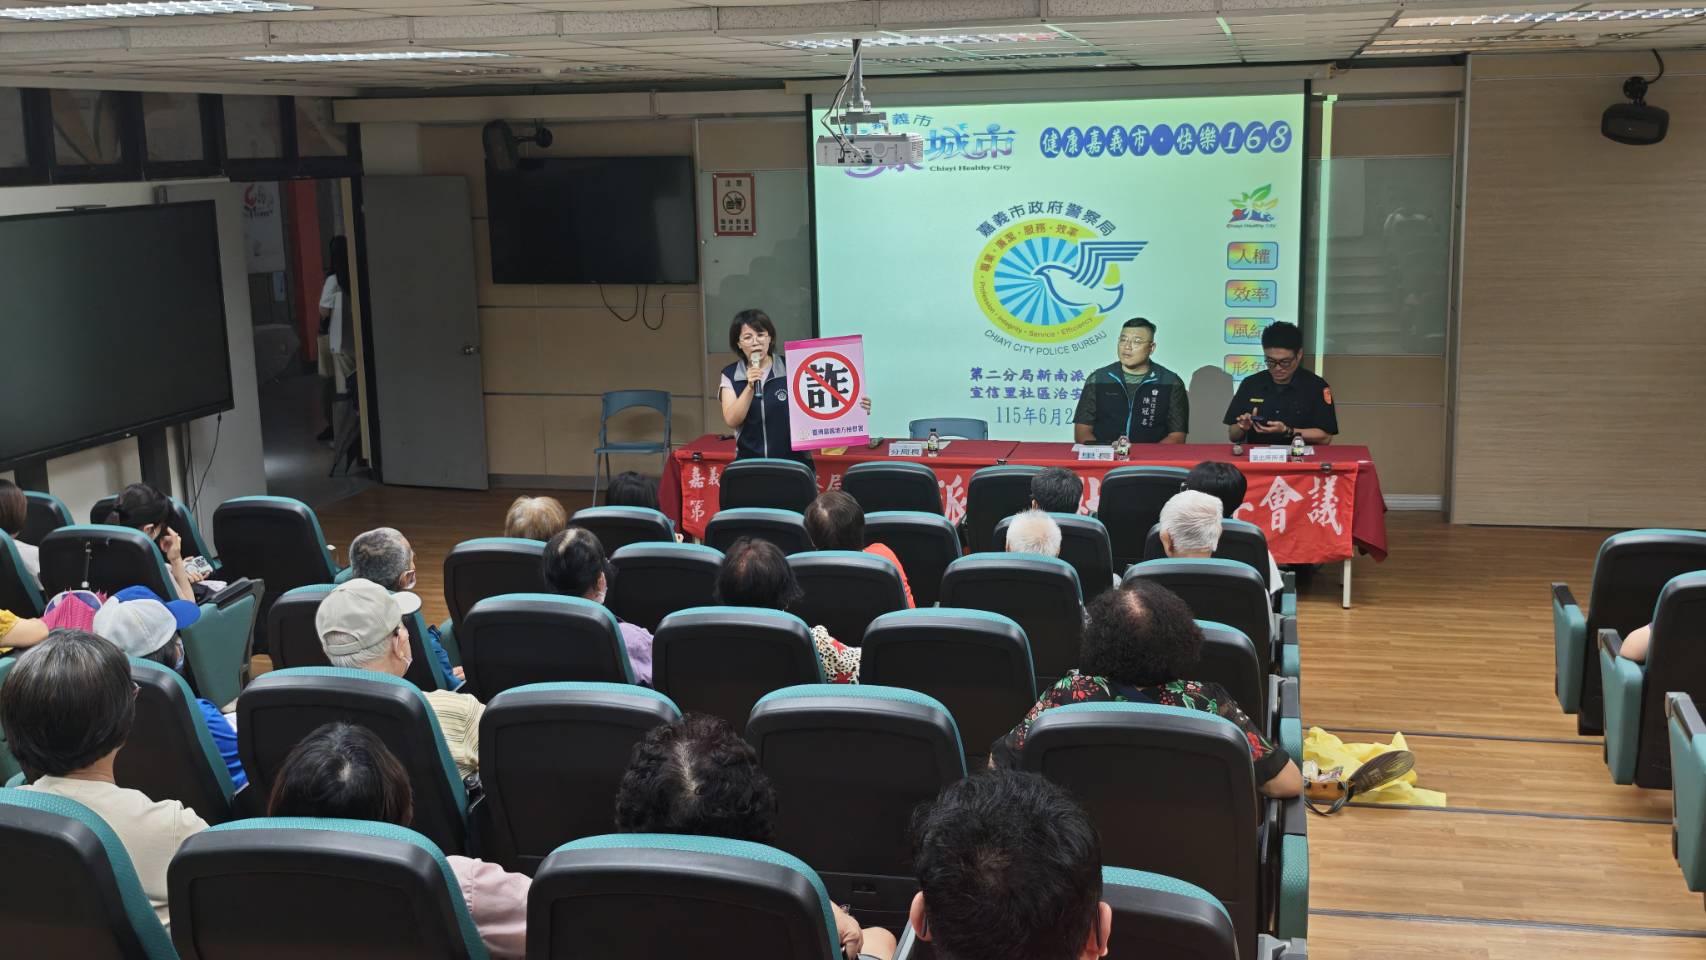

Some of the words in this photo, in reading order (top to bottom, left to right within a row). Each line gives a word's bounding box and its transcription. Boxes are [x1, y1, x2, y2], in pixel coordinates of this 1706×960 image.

[976, 200, 1117, 238] 嘉義市政府警察局
[1235, 249, 1271, 265] 人權
[1233, 286, 1270, 303] 效率
[984, 329, 1012, 349] CHIAYI
[1013, 343, 1035, 355] CITY
[1035, 345, 1070, 356] POLICE
[1072, 331, 1108, 351] BUREAU
[804, 362, 849, 409] 詐
